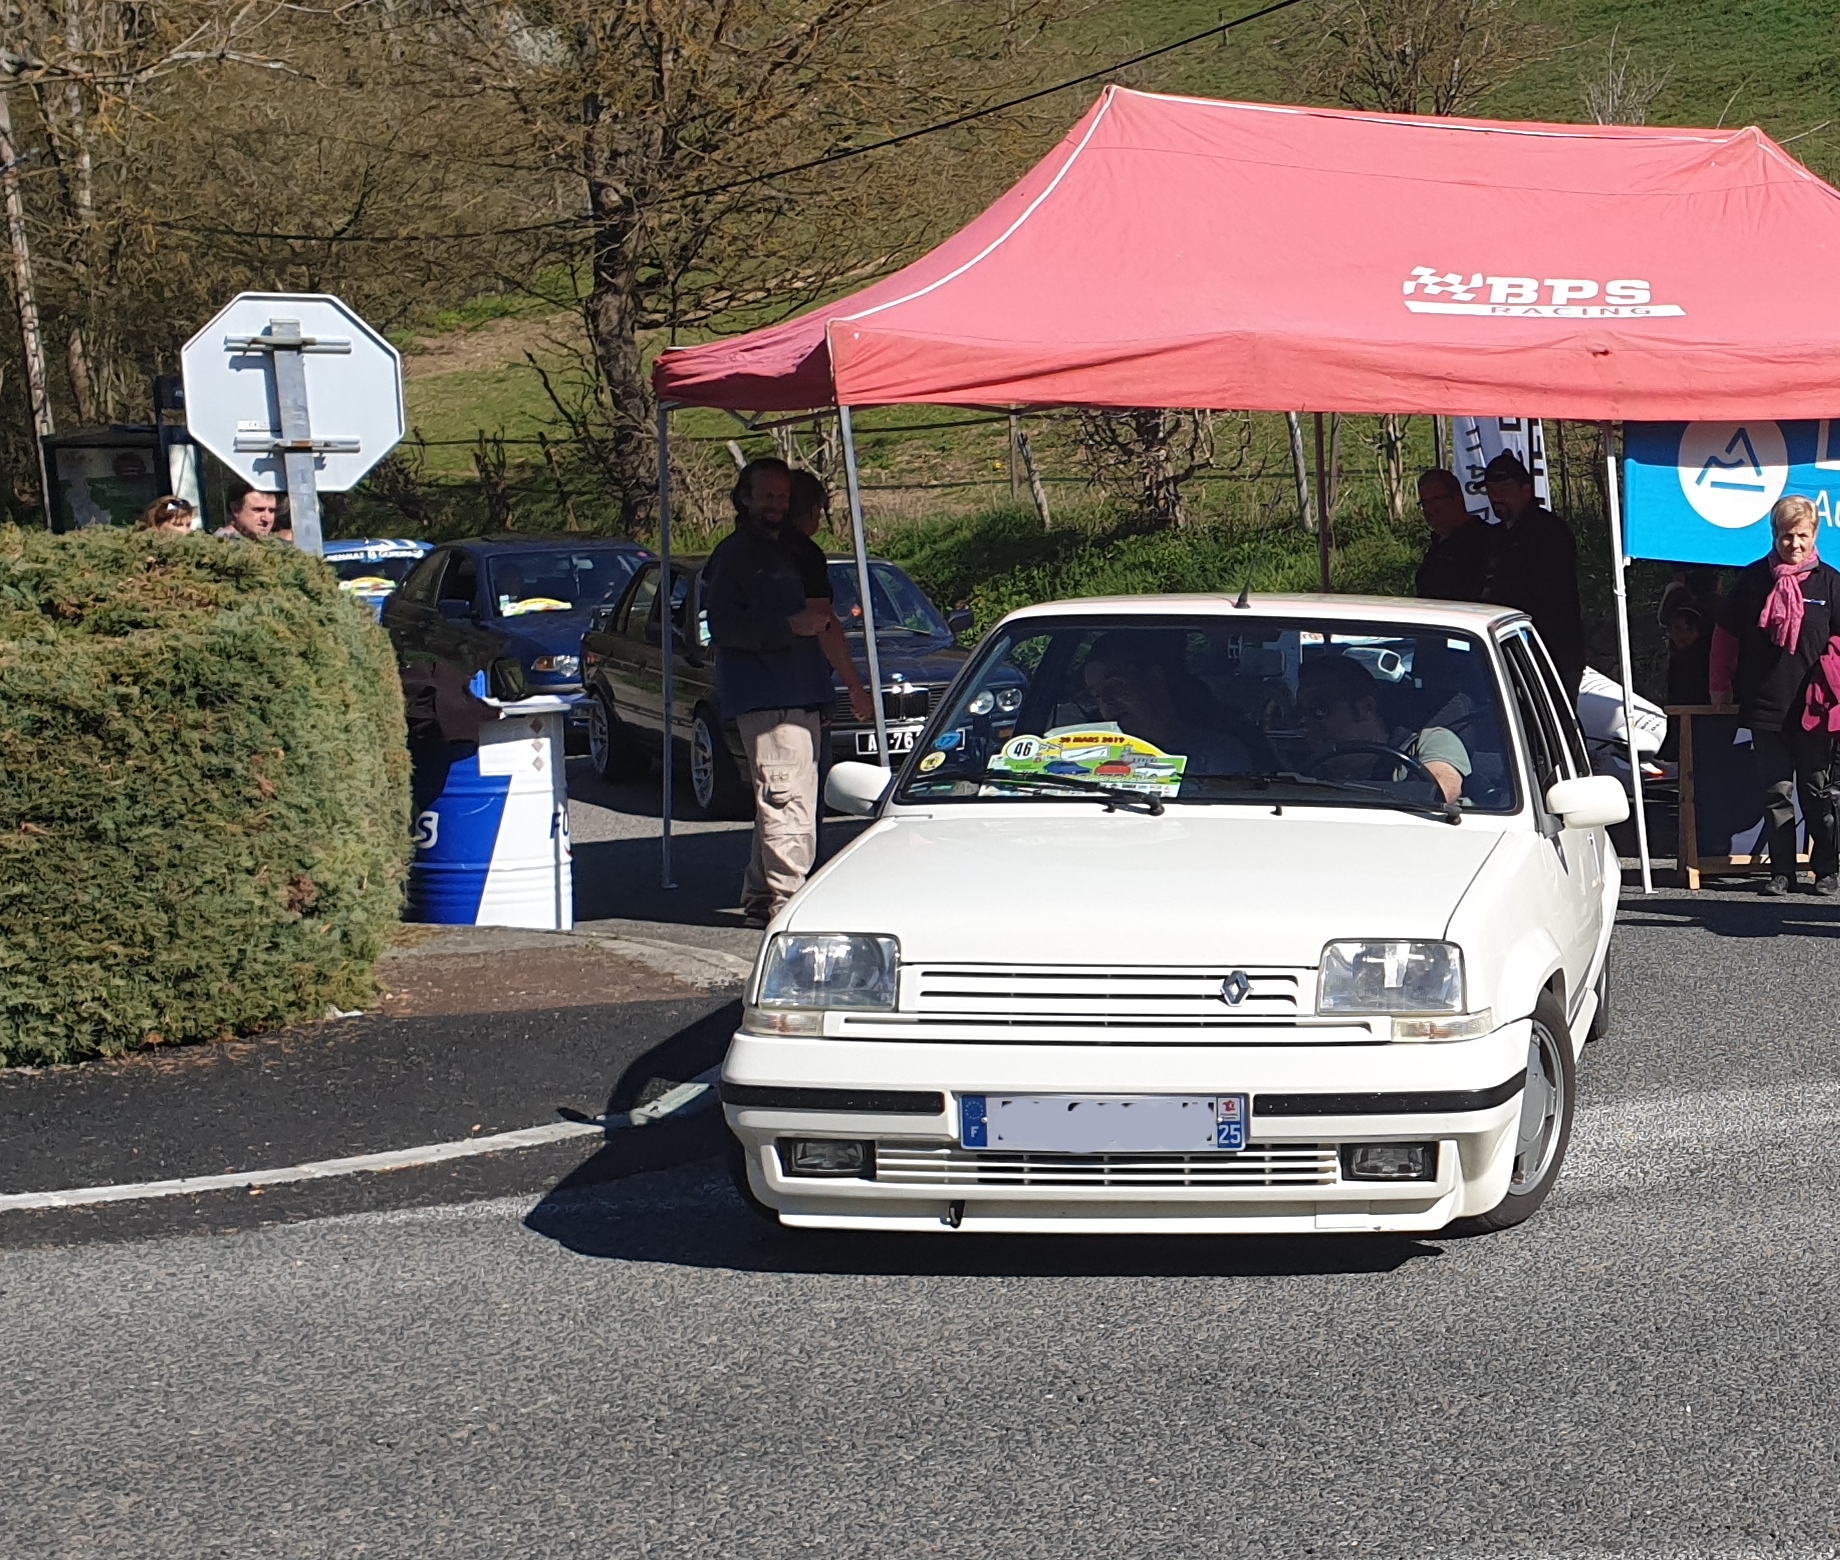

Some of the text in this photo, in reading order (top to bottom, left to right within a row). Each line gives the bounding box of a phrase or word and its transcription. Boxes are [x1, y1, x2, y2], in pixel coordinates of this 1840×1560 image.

[1486, 276, 1651, 305] BPS
[1491, 306, 1651, 316] RACING
[1013, 742, 1032, 757] 46
[971, 1126, 979, 1138] F
[1219, 1125, 1240, 1144] 25
